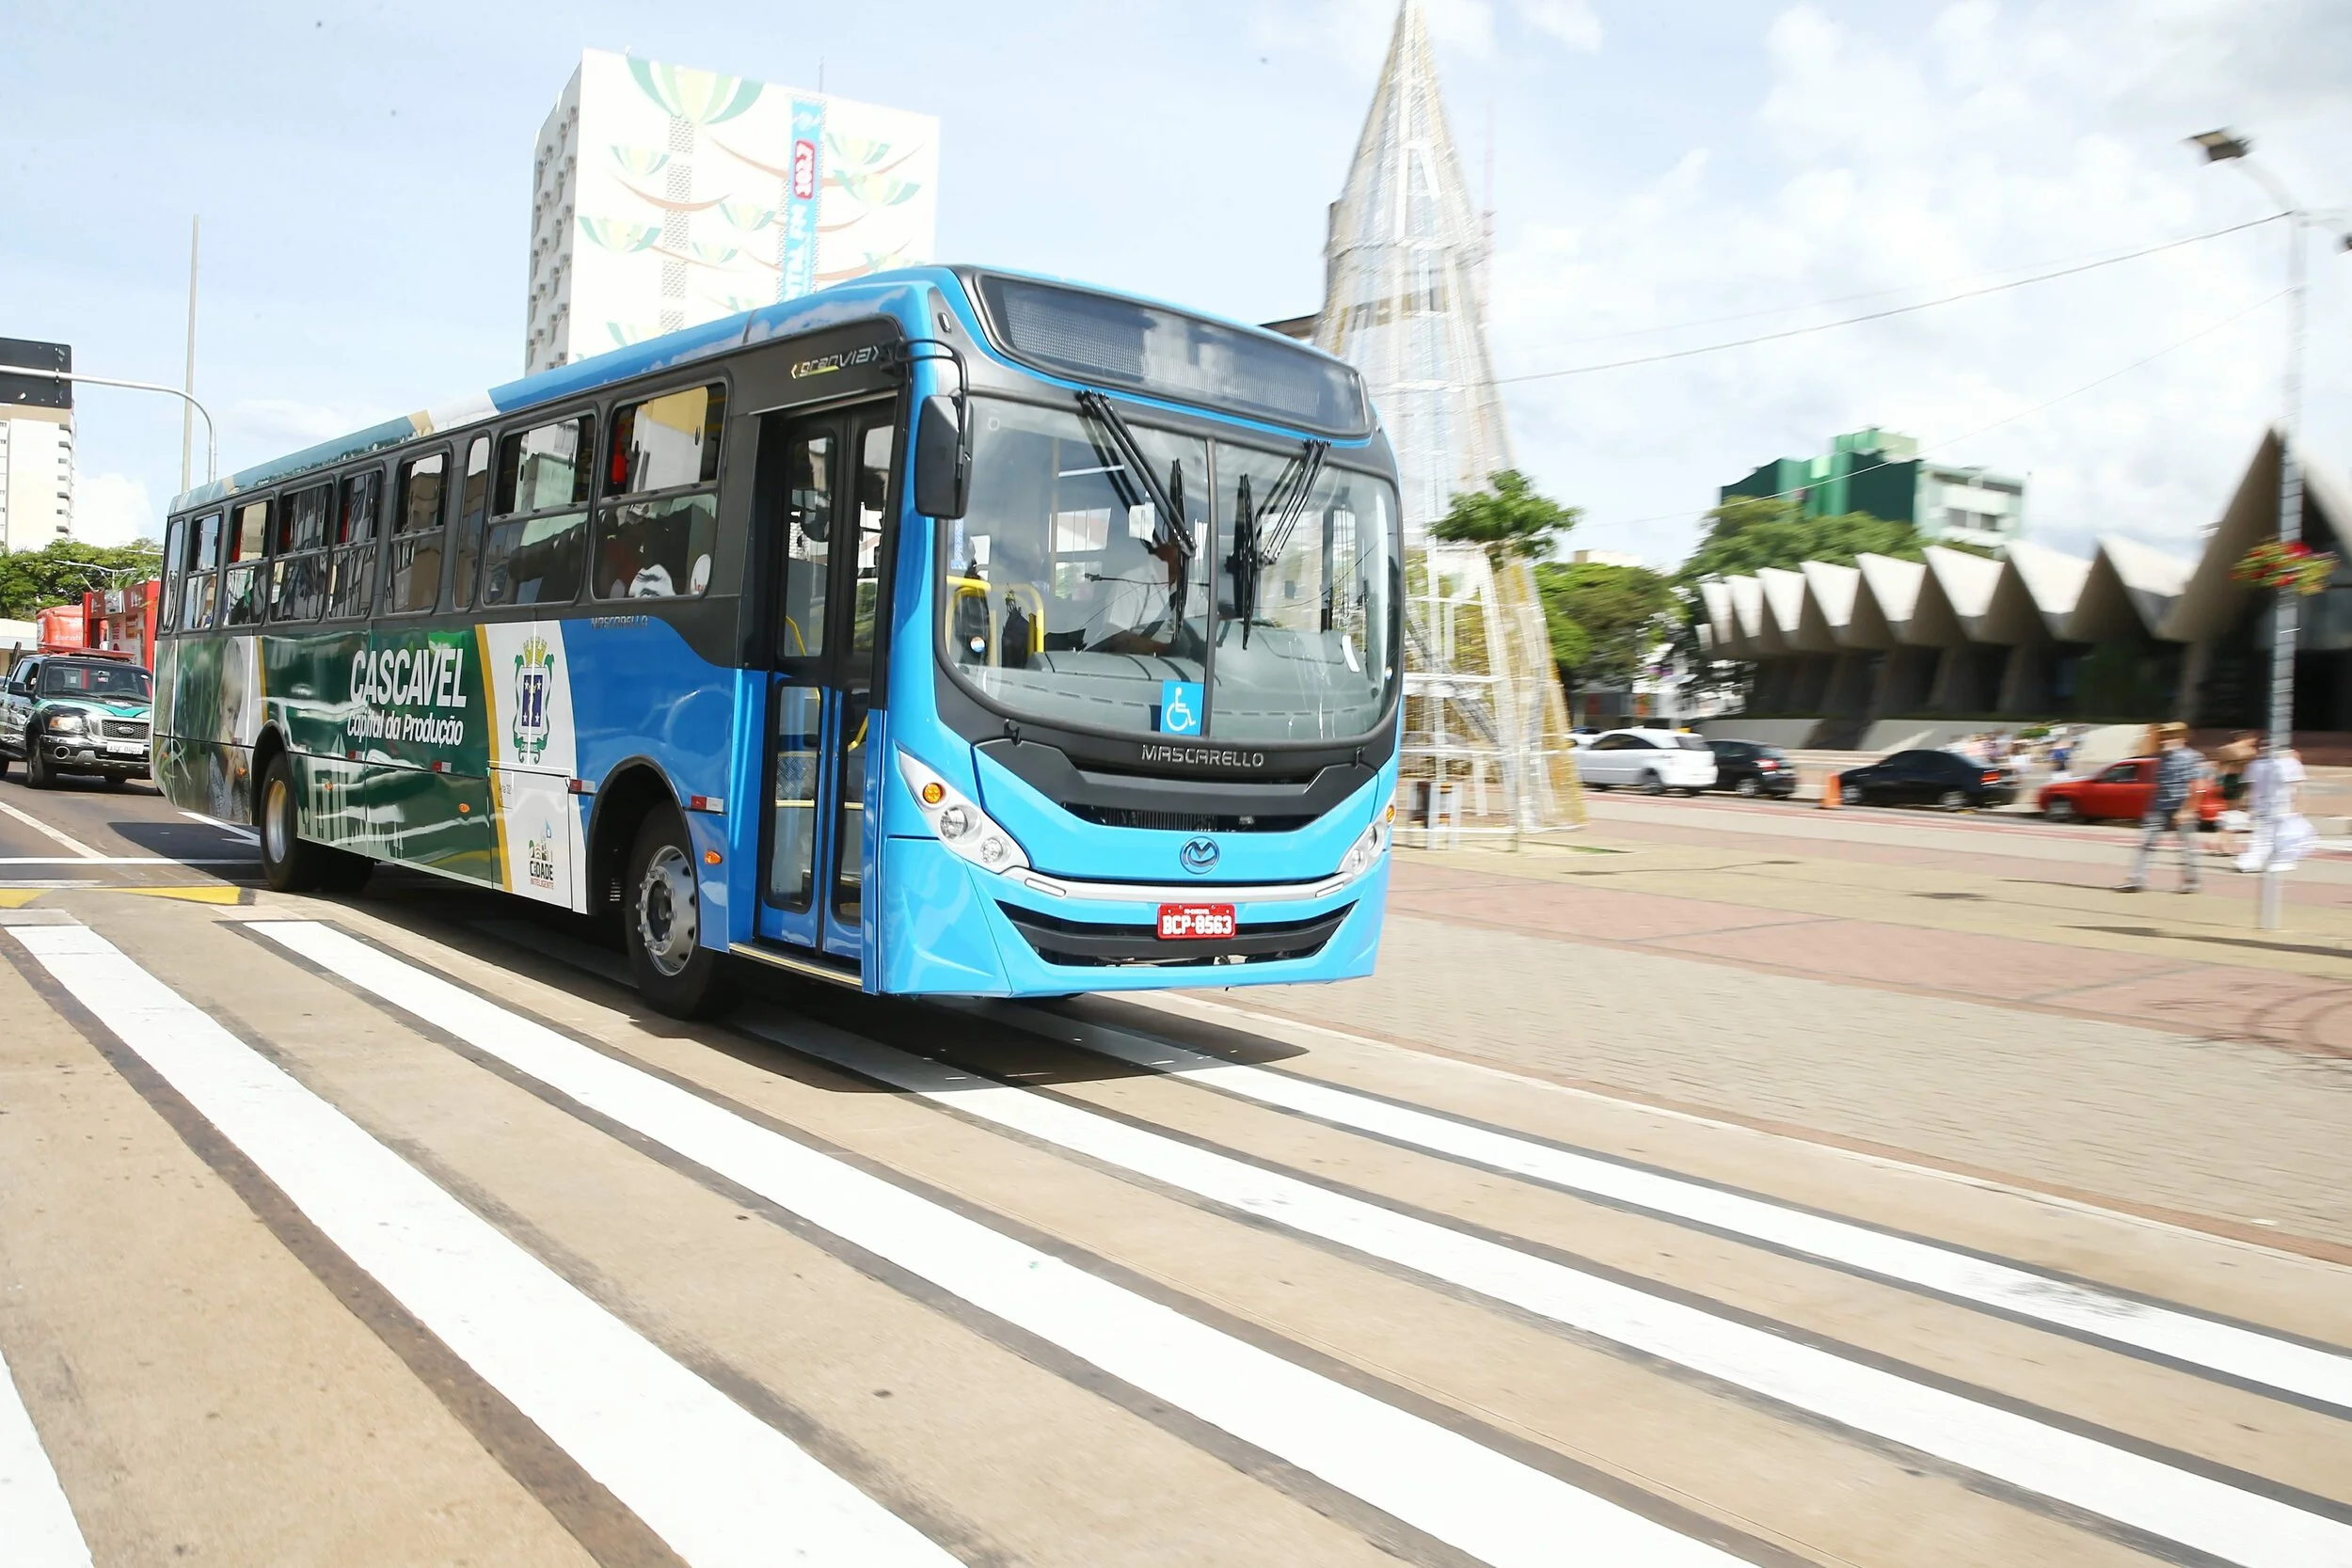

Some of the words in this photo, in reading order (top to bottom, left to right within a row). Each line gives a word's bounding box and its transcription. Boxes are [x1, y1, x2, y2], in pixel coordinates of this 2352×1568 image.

[350, 648, 468, 707] CASCAVEL
[346, 709, 385, 743] Capital
[385, 711, 402, 740] da
[402, 712, 464, 748] Produção
[1141, 744, 1264, 768] MASCARELLO
[530, 860, 554, 881] CIDADE
